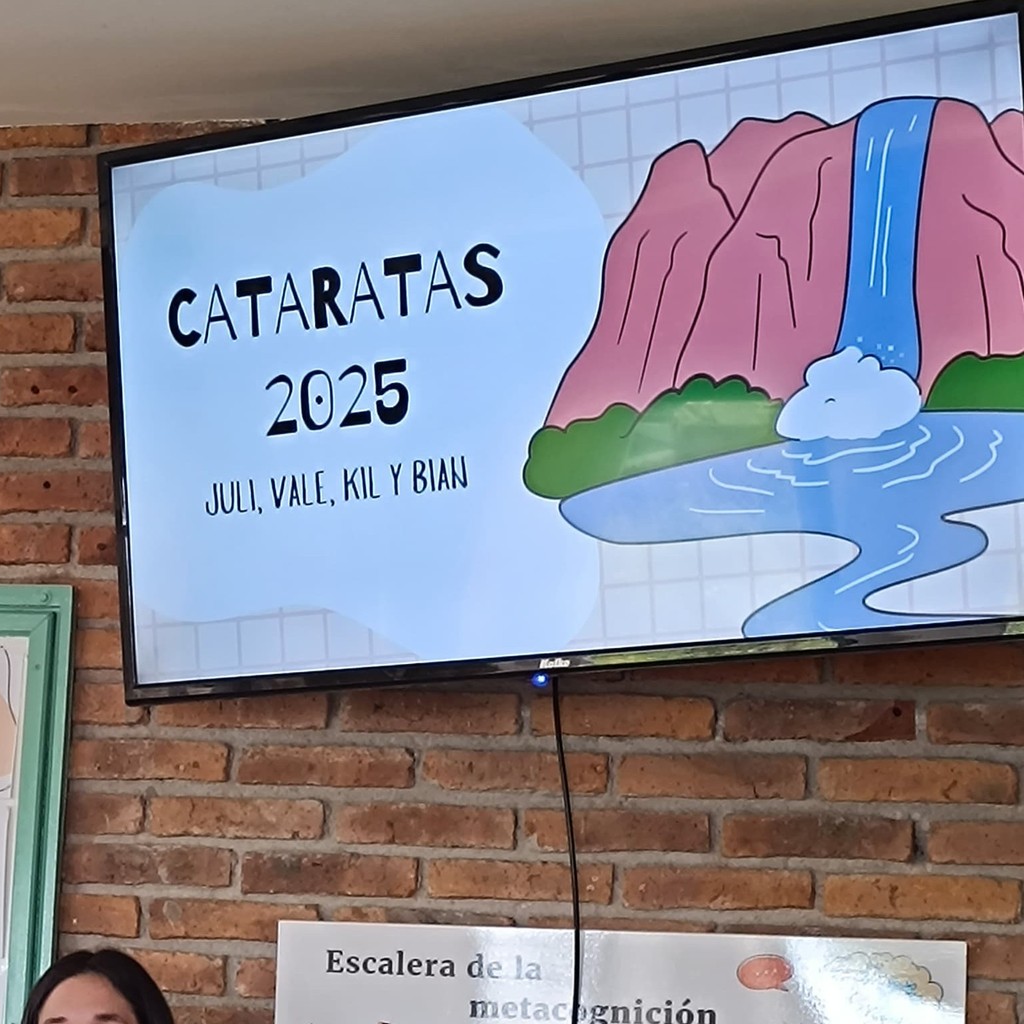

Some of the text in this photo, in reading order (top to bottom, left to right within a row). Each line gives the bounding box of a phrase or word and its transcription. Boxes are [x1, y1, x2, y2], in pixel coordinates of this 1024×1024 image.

[168, 243, 504, 348] CATARATAS
[265, 358, 410, 437] 2025
[205, 455, 469, 516] JULI, VALE, KIL Y BIAN
[326, 949, 543, 981] Escalera de la
